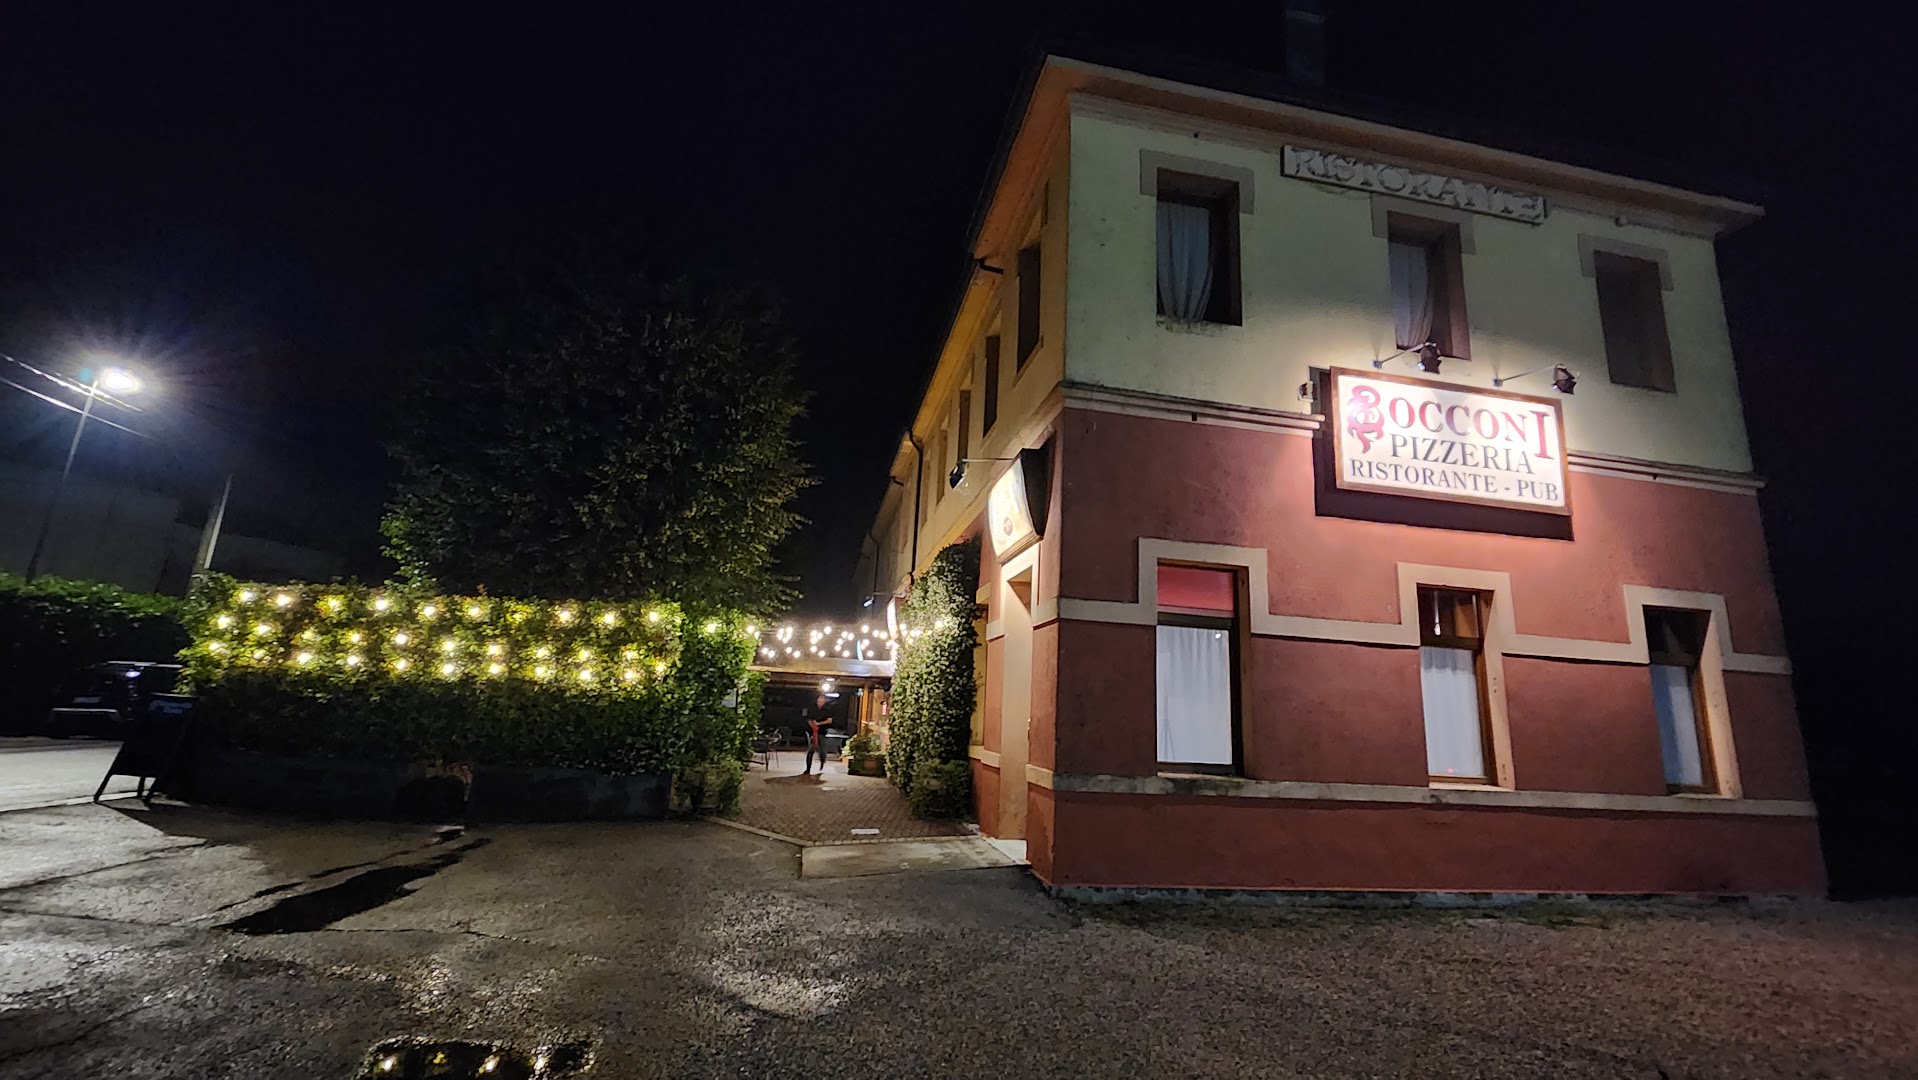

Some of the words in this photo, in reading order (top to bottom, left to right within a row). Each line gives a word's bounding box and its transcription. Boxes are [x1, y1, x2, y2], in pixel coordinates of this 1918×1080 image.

[1291, 148, 1543, 221] RISTORANTE
[1348, 385, 1554, 459] BOCCONI
[1351, 459, 1498, 493] RISTORANTE
[1517, 479, 1558, 501] PUB
[1390, 434, 1535, 474] PIZZERIA
